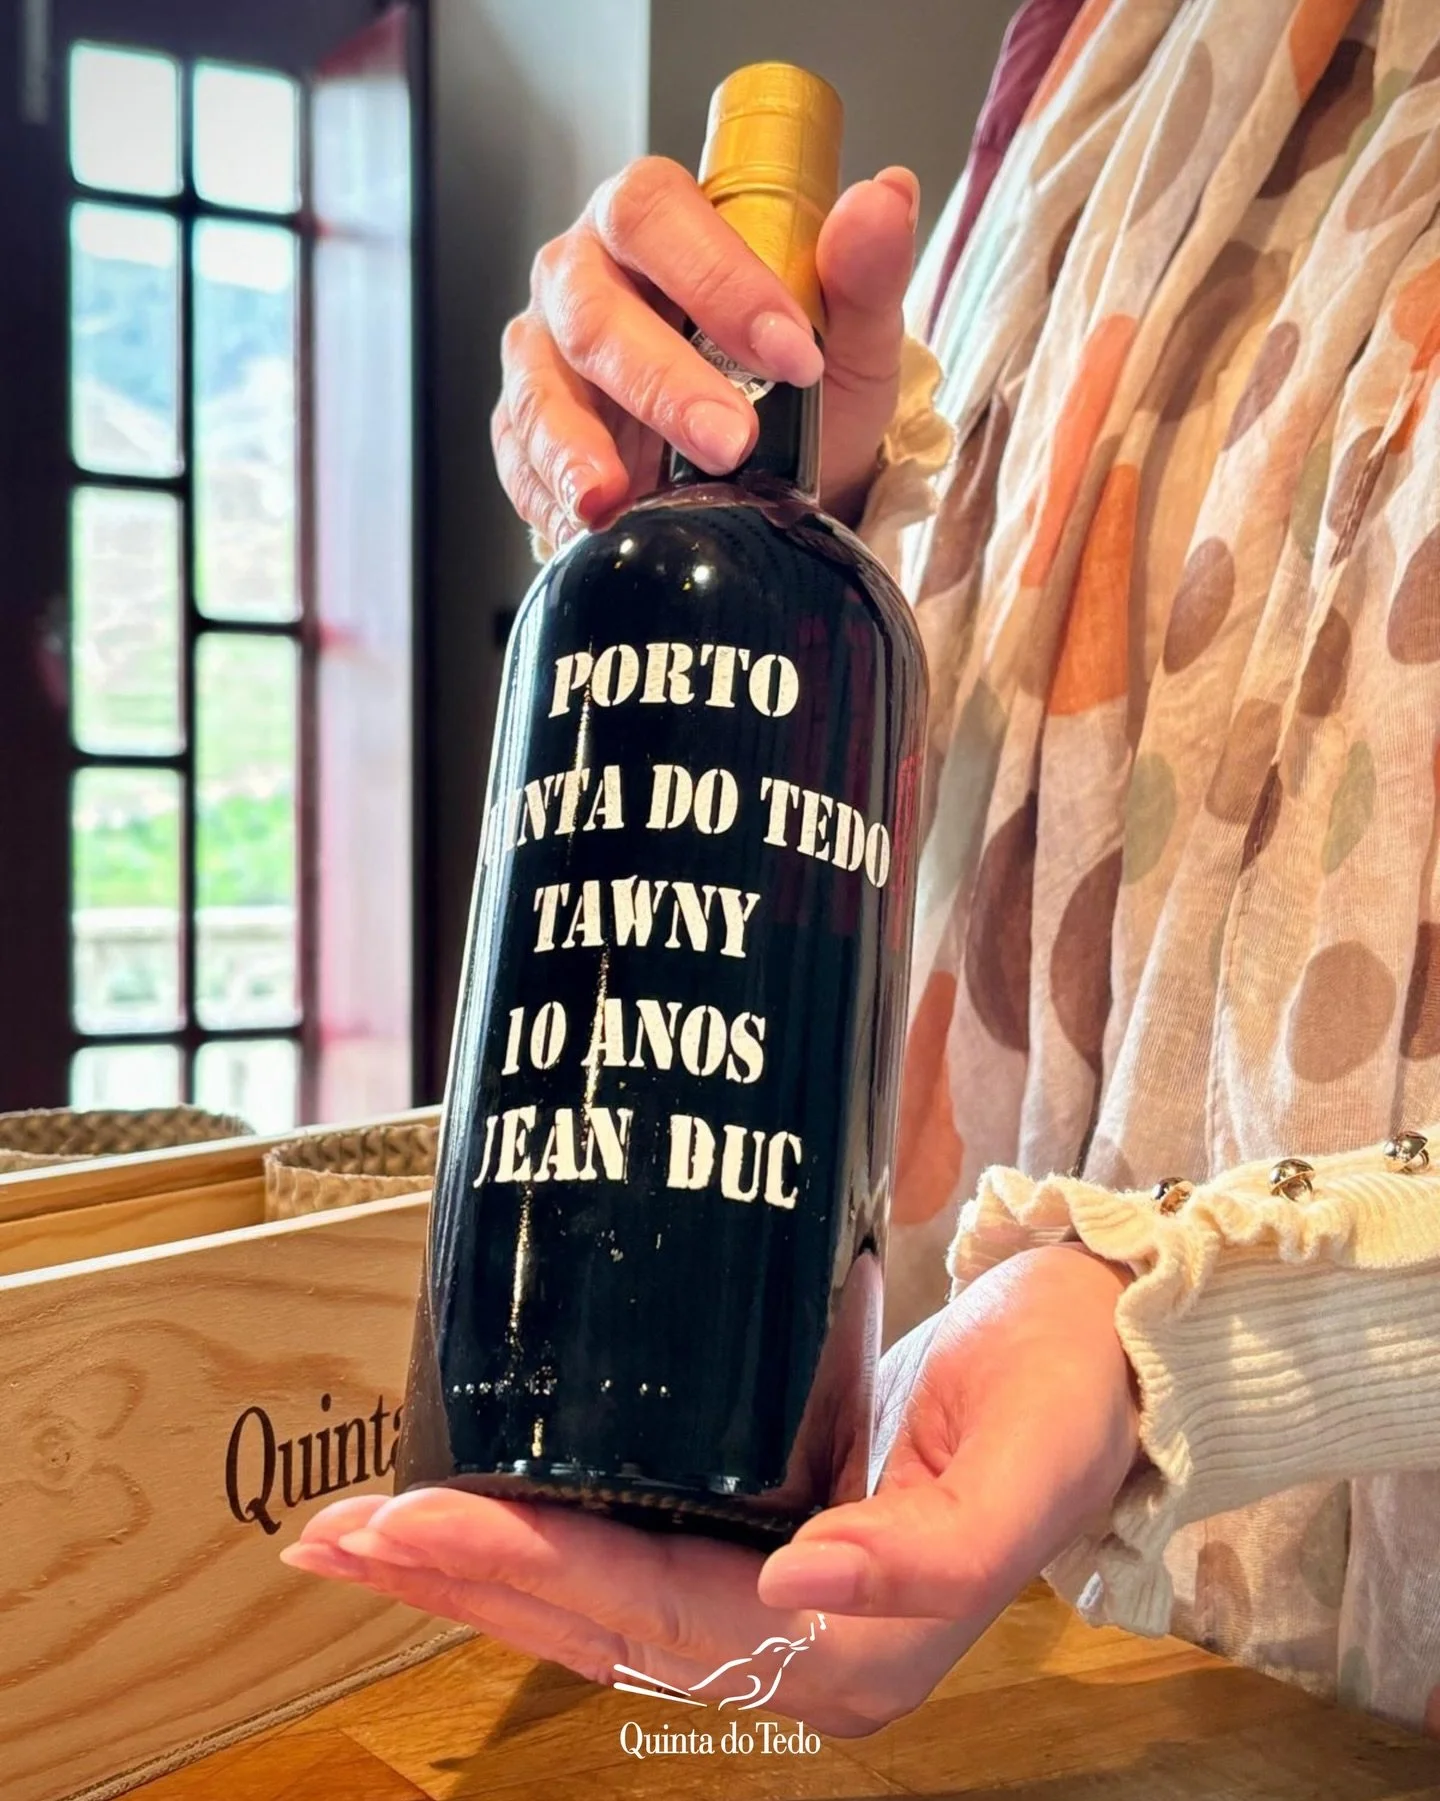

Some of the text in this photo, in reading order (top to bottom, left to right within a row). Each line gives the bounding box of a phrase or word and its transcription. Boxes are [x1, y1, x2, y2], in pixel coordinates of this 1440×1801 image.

[548, 642, 799, 718] PORTO
[646, 764, 738, 834] DO
[760, 777, 891, 888] TEDO
[533, 875, 761, 958] TAWNY
[502, 998, 766, 1084] 10 ANOS
[473, 1105, 802, 1210] JEAN DUC
